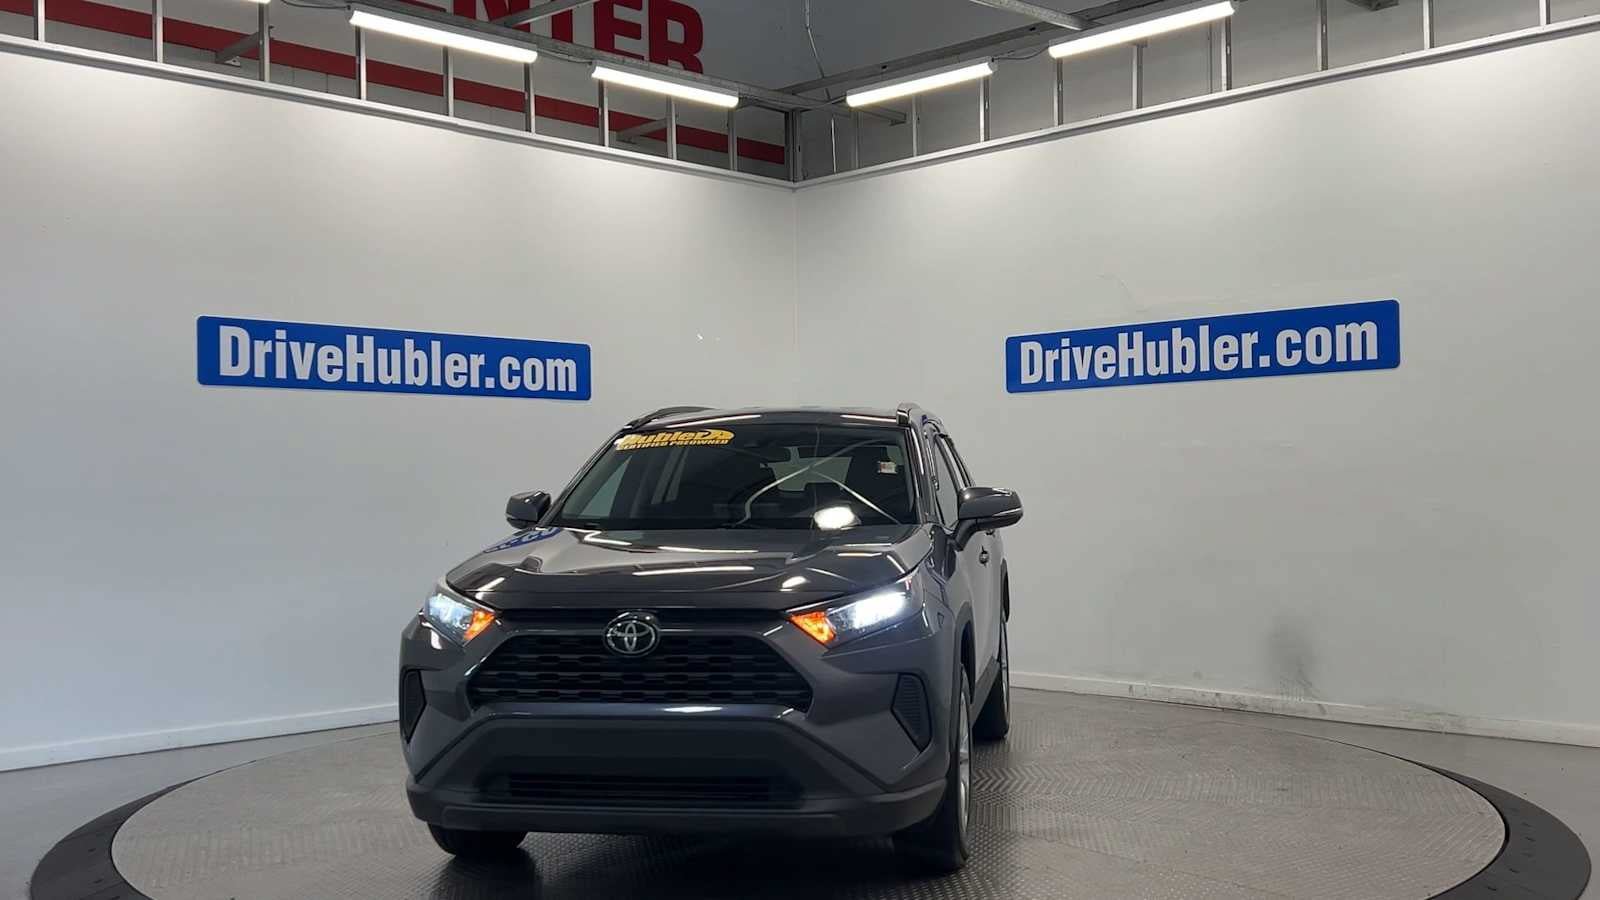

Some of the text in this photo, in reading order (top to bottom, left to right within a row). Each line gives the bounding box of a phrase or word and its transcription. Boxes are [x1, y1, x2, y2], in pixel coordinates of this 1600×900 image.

[390, 0, 705, 75] NTER
[219, 325, 577, 392] DriveHubler.com
[1020, 320, 1378, 384] DriveHubler.com
